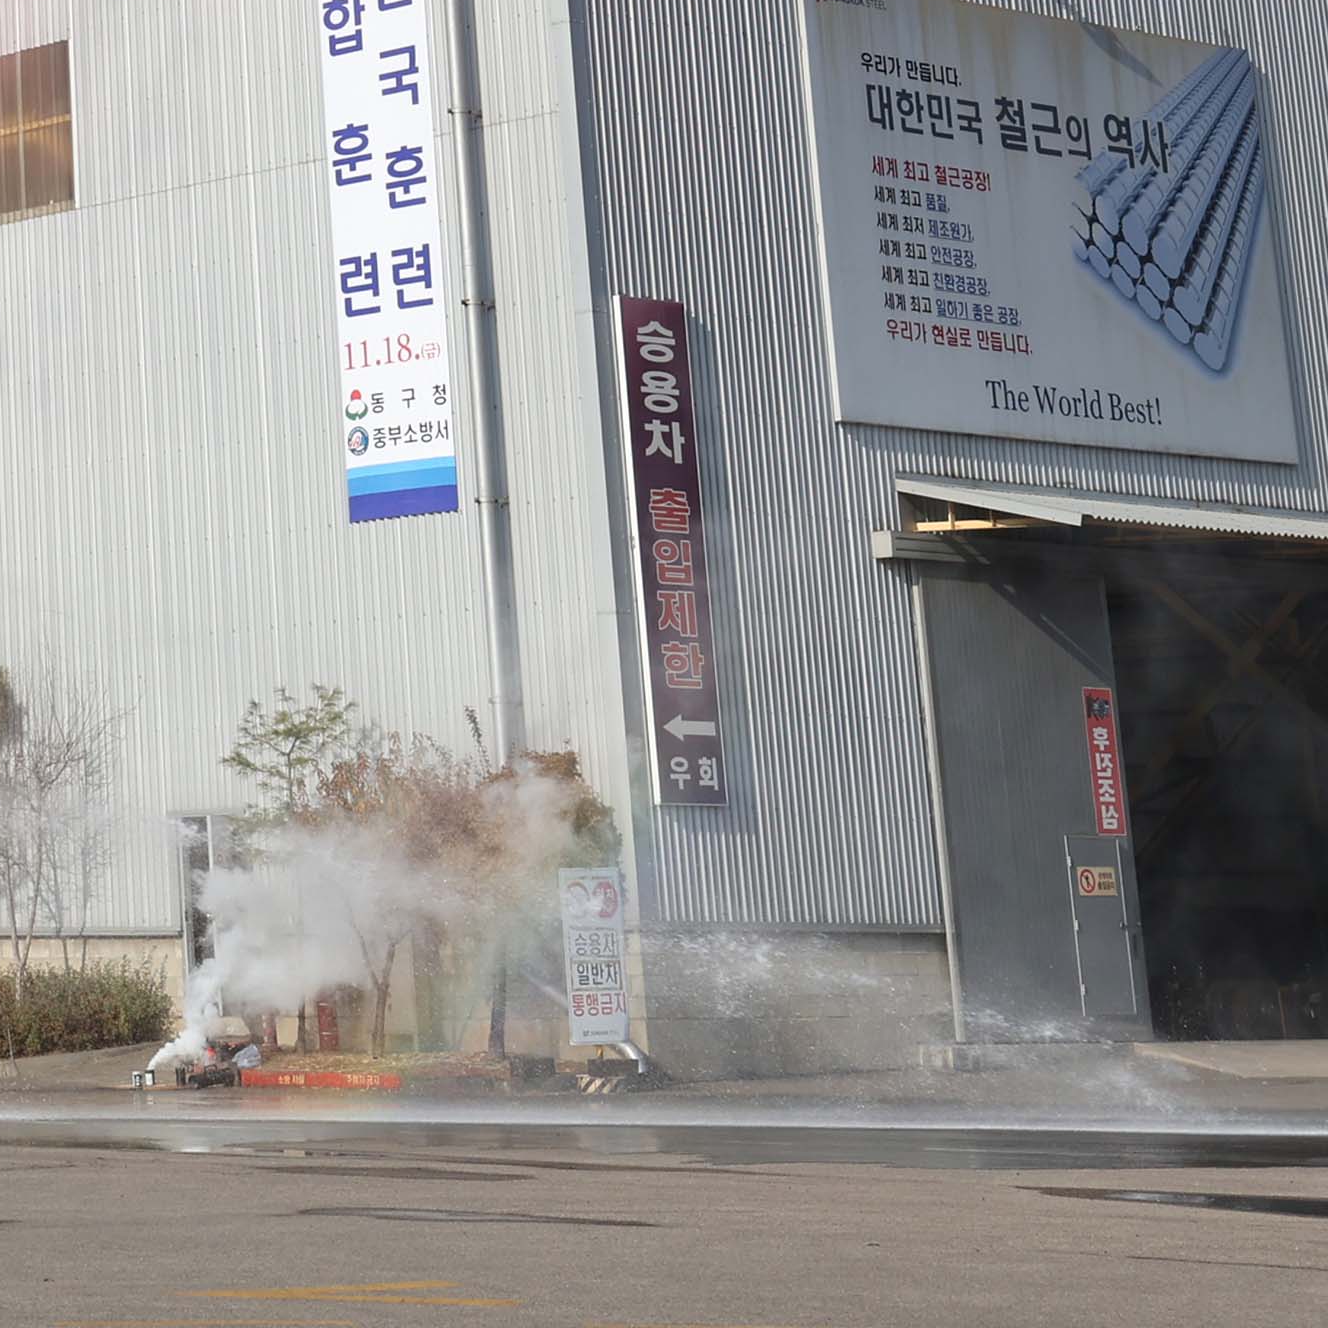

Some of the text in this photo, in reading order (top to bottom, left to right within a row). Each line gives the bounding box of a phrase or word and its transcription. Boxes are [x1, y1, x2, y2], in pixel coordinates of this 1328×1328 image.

[860, 51, 962, 87] 우리가 만듭니다.
[865, 83, 1171, 174] 대한민국 철근의 역사
[872, 155, 992, 192] 세계 최고 철근공장!
[874, 185, 896, 205] 세계
[900, 189, 921, 208] 최고
[876, 212, 899, 231] 세계
[902, 216, 925, 234] 최저
[879, 238, 902, 258] 세계
[905, 243, 927, 260] 최고
[881, 265, 904, 285] 세계
[907, 269, 930, 287] 최고
[884, 291, 906, 311] 세계
[910, 295, 932, 314] 최고
[935, 298, 968, 320] 일하기
[972, 302, 994, 322] 좋은
[886, 319, 1033, 356] 우리가 현실로 만듭니다.
[636, 320, 686, 464] 승용차
[985, 379, 1162, 425] The World Best!
[373, 419, 449, 449] 중부소방서
[649, 488, 704, 689] 출입제한
[577, 962, 619, 986] 일반차
[572, 992, 627, 1017] 통행금지
